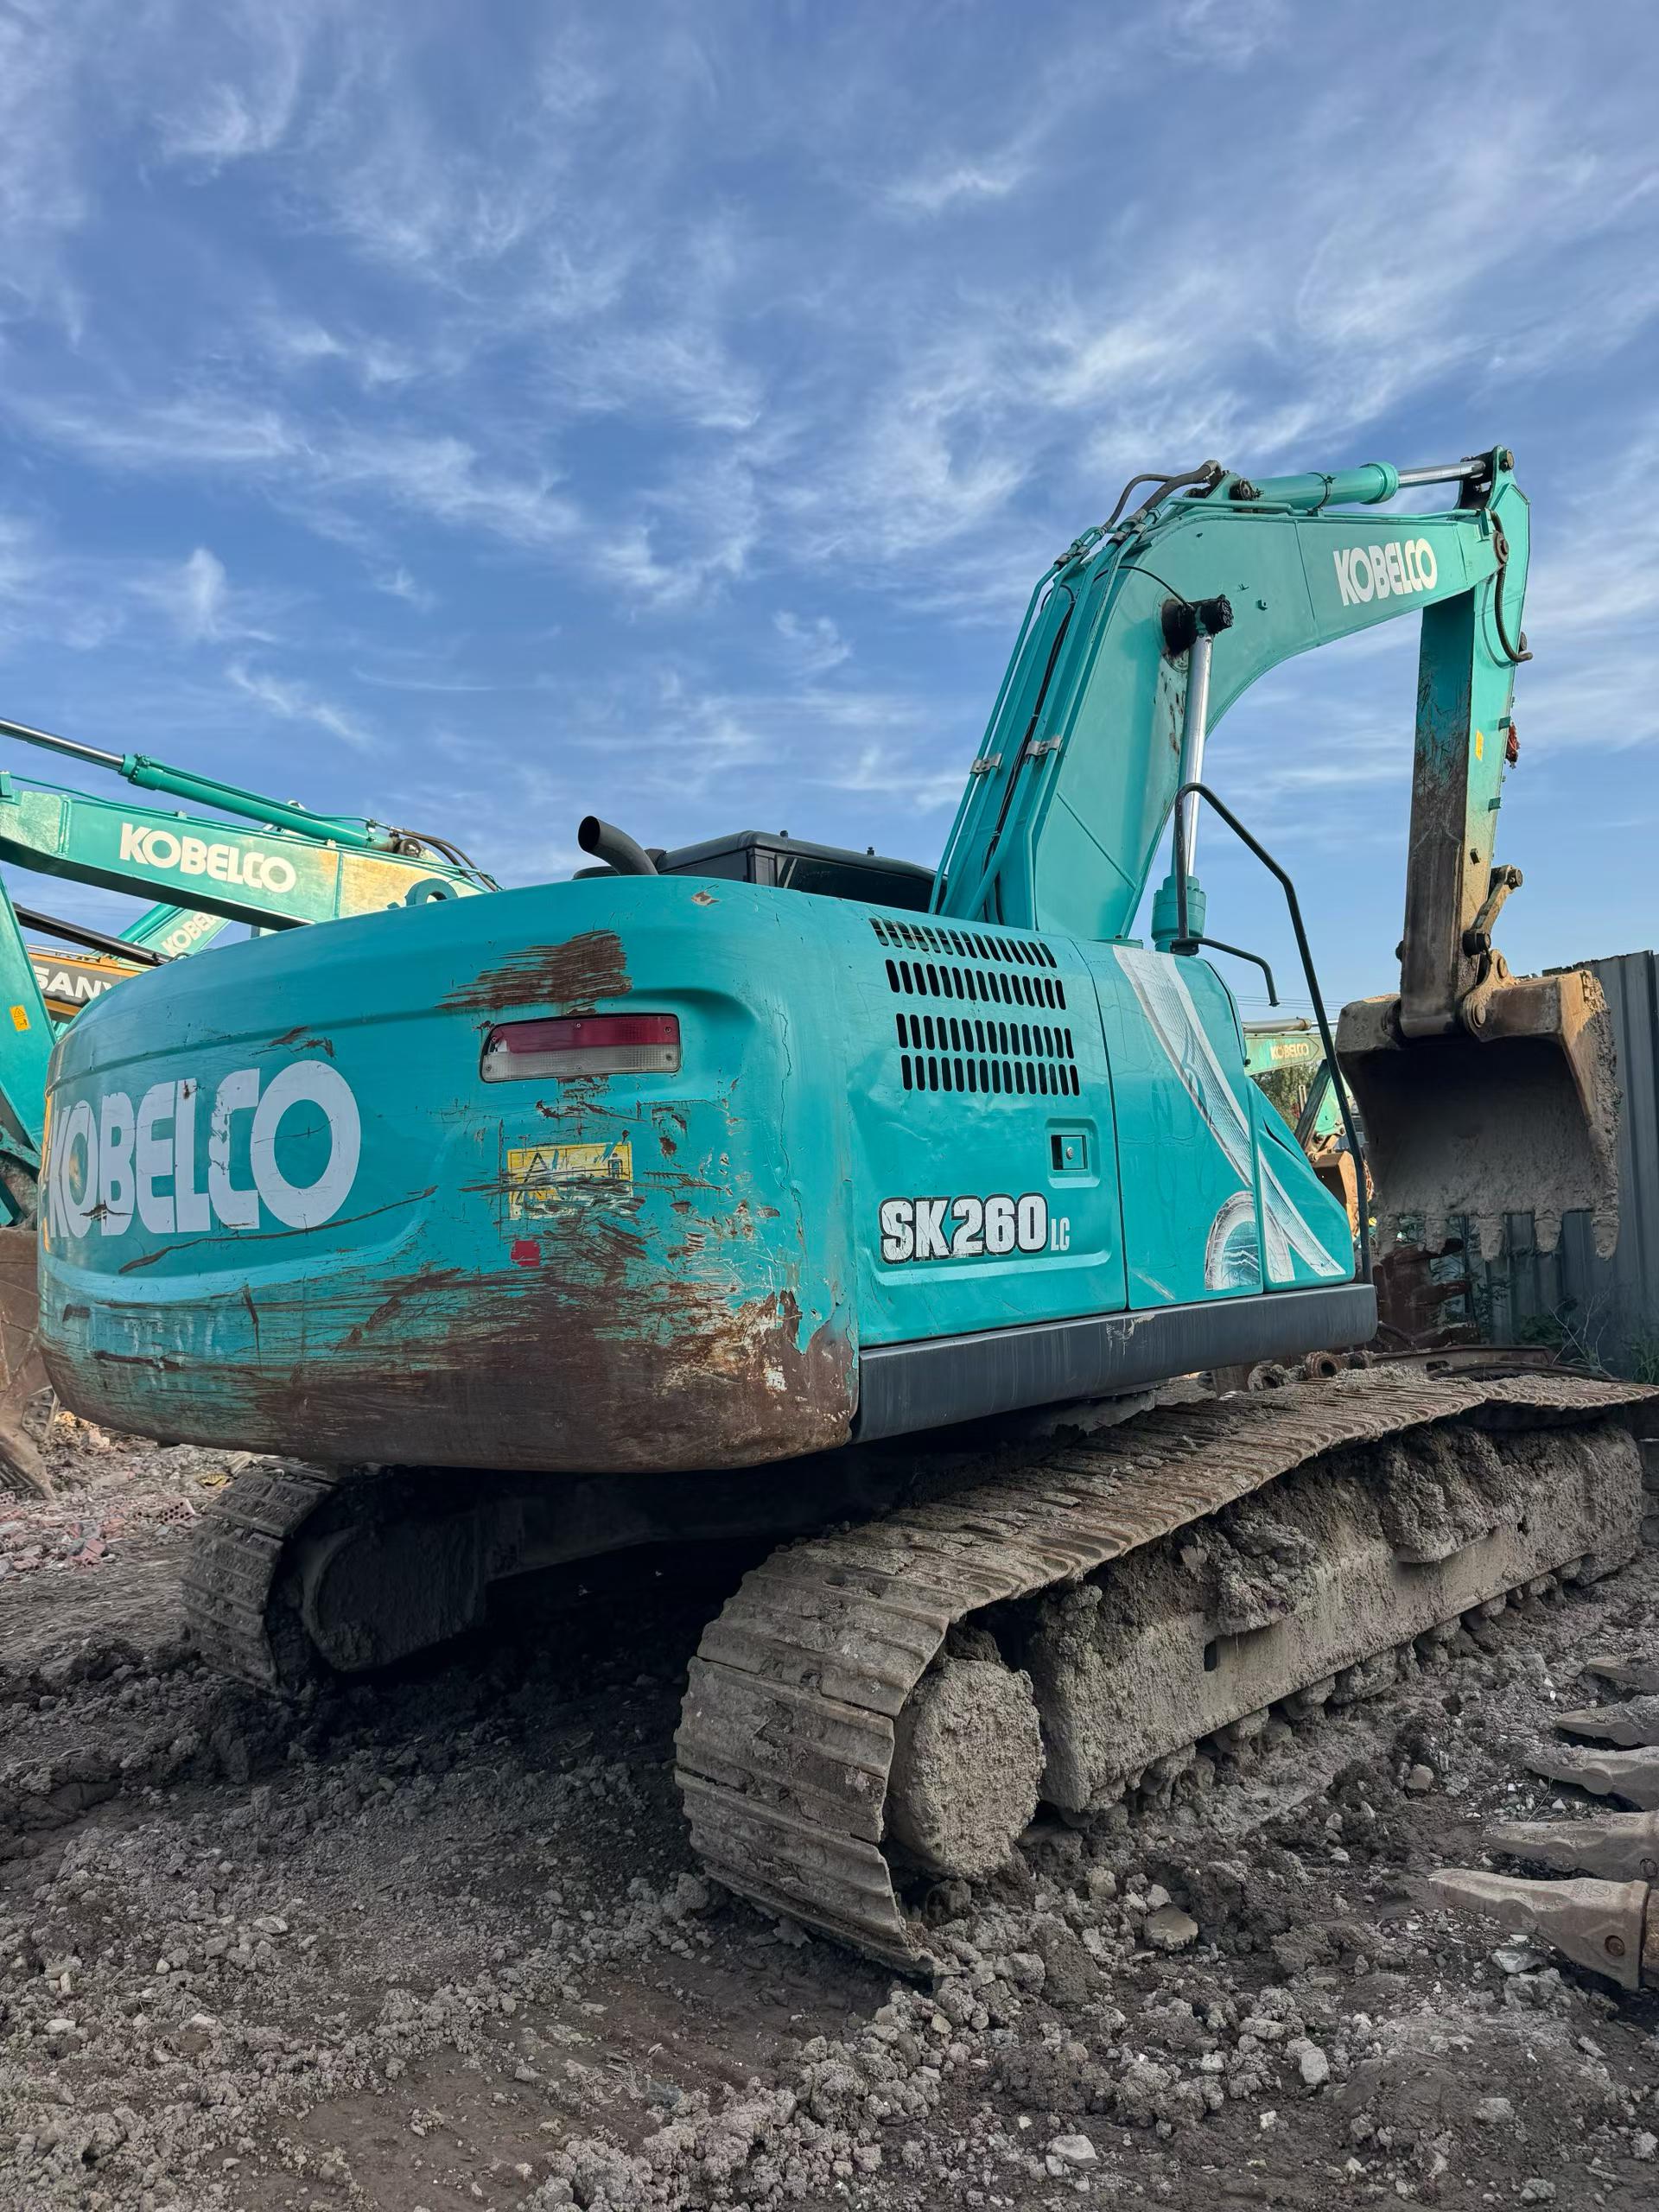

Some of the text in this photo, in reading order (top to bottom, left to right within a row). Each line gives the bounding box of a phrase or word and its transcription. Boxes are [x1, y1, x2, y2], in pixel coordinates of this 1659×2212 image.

[1332, 538, 1437, 607] KOBELCO
[119, 823, 296, 893] KOBELCO
[161, 912, 223, 958] KOBEL
[48, 1059, 361, 1238] KOBELCO
[879, 1192, 1071, 1264] SK260 LC
